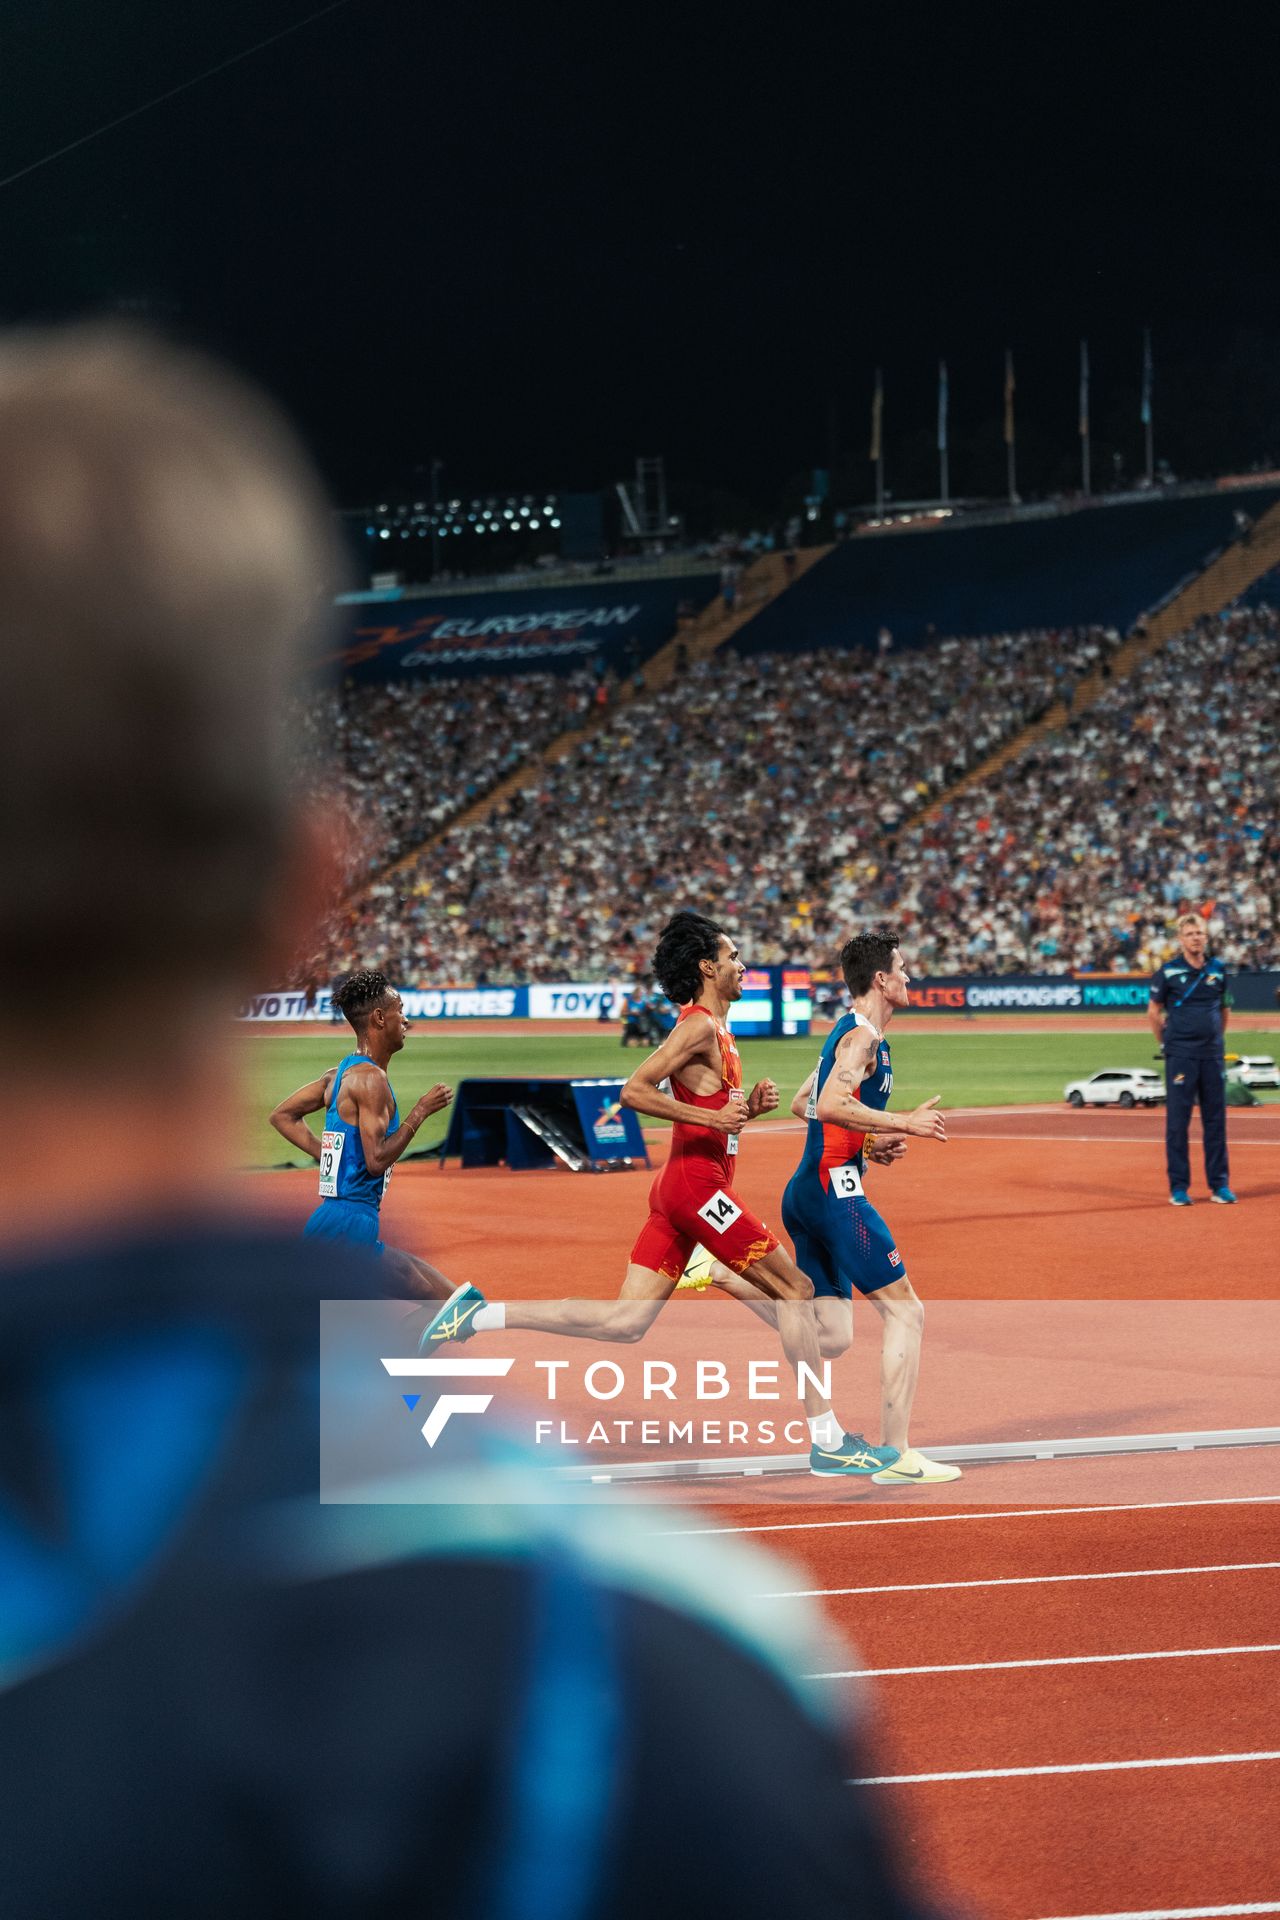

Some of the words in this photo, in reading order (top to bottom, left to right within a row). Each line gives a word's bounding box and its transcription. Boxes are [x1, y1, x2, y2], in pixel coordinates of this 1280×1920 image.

[431, 605, 640, 639] EUROPEAN
[444, 990, 516, 1016] TIRES
[551, 992, 614, 1012] TOYO
[966, 985, 1082, 1007] CHAMPIONSHIPS
[1083, 985, 1149, 1006] MUNICH
[706, 1198, 735, 1225] 14
